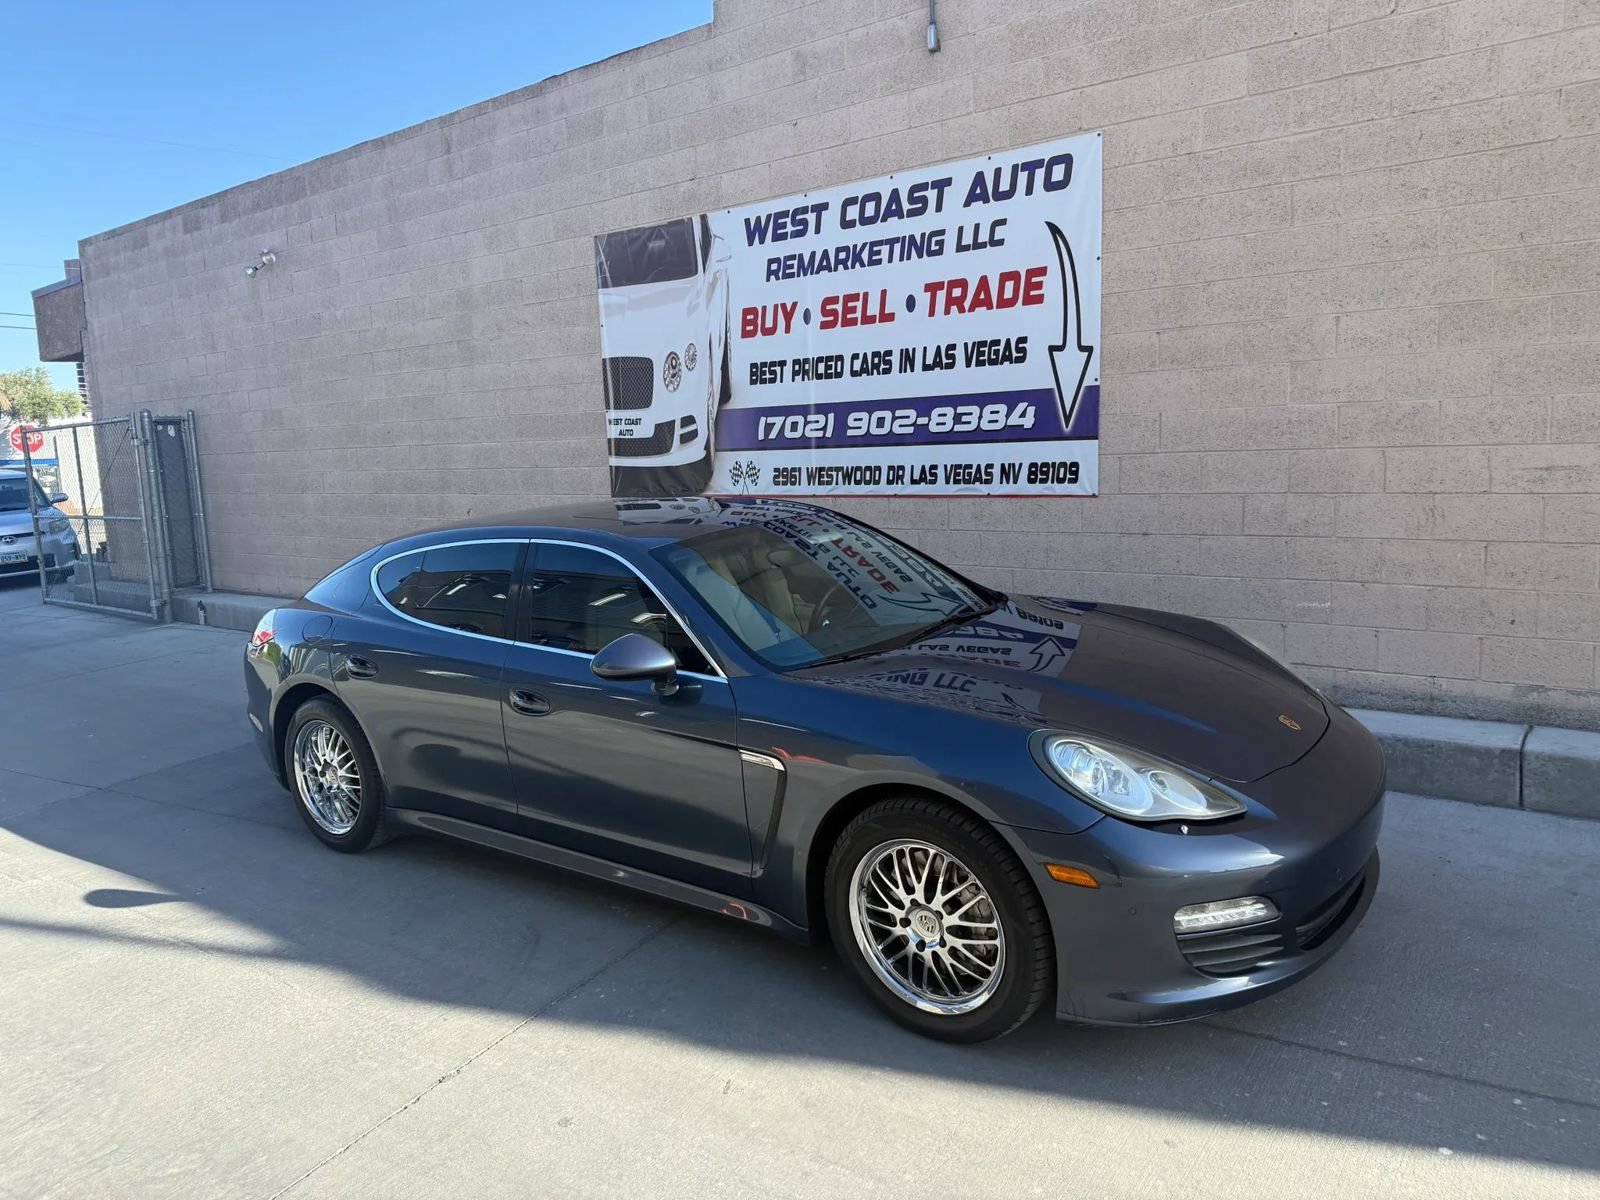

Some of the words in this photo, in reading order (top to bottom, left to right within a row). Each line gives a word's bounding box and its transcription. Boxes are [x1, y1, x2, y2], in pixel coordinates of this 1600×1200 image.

[744, 201, 829, 247] WEST
[840, 177, 953, 230] COAST
[963, 153, 1074, 208] AUTO
[766, 228, 946, 283] REMARKETING
[955, 218, 1008, 253] LLC
[741, 301, 798, 339] BUY
[820, 289, 896, 330] SELL
[924, 266, 1048, 318] TRADE
[749, 360, 787, 385] BEST
[791, 354, 845, 382] PRICED
[850, 350, 893, 377] CARS
[898, 347, 916, 374] IN
[922, 343, 957, 372] LAS
[964, 336, 1028, 368] VEGAS
[12, 432, 42, 445] SOP
[618, 429, 634, 437] AUTO
[758, 412, 835, 441] (702)
[846, 402, 1036, 436] 902-8384
[772, 467, 802, 486] 2961
[806, 465, 881, 486] WESTWOOD
[886, 465, 906, 486] DR
[910, 464, 938, 485] LAS
[944, 463, 994, 485] VEGAS
[1000, 463, 1022, 485] NV
[1027, 461, 1080, 484] 89109
